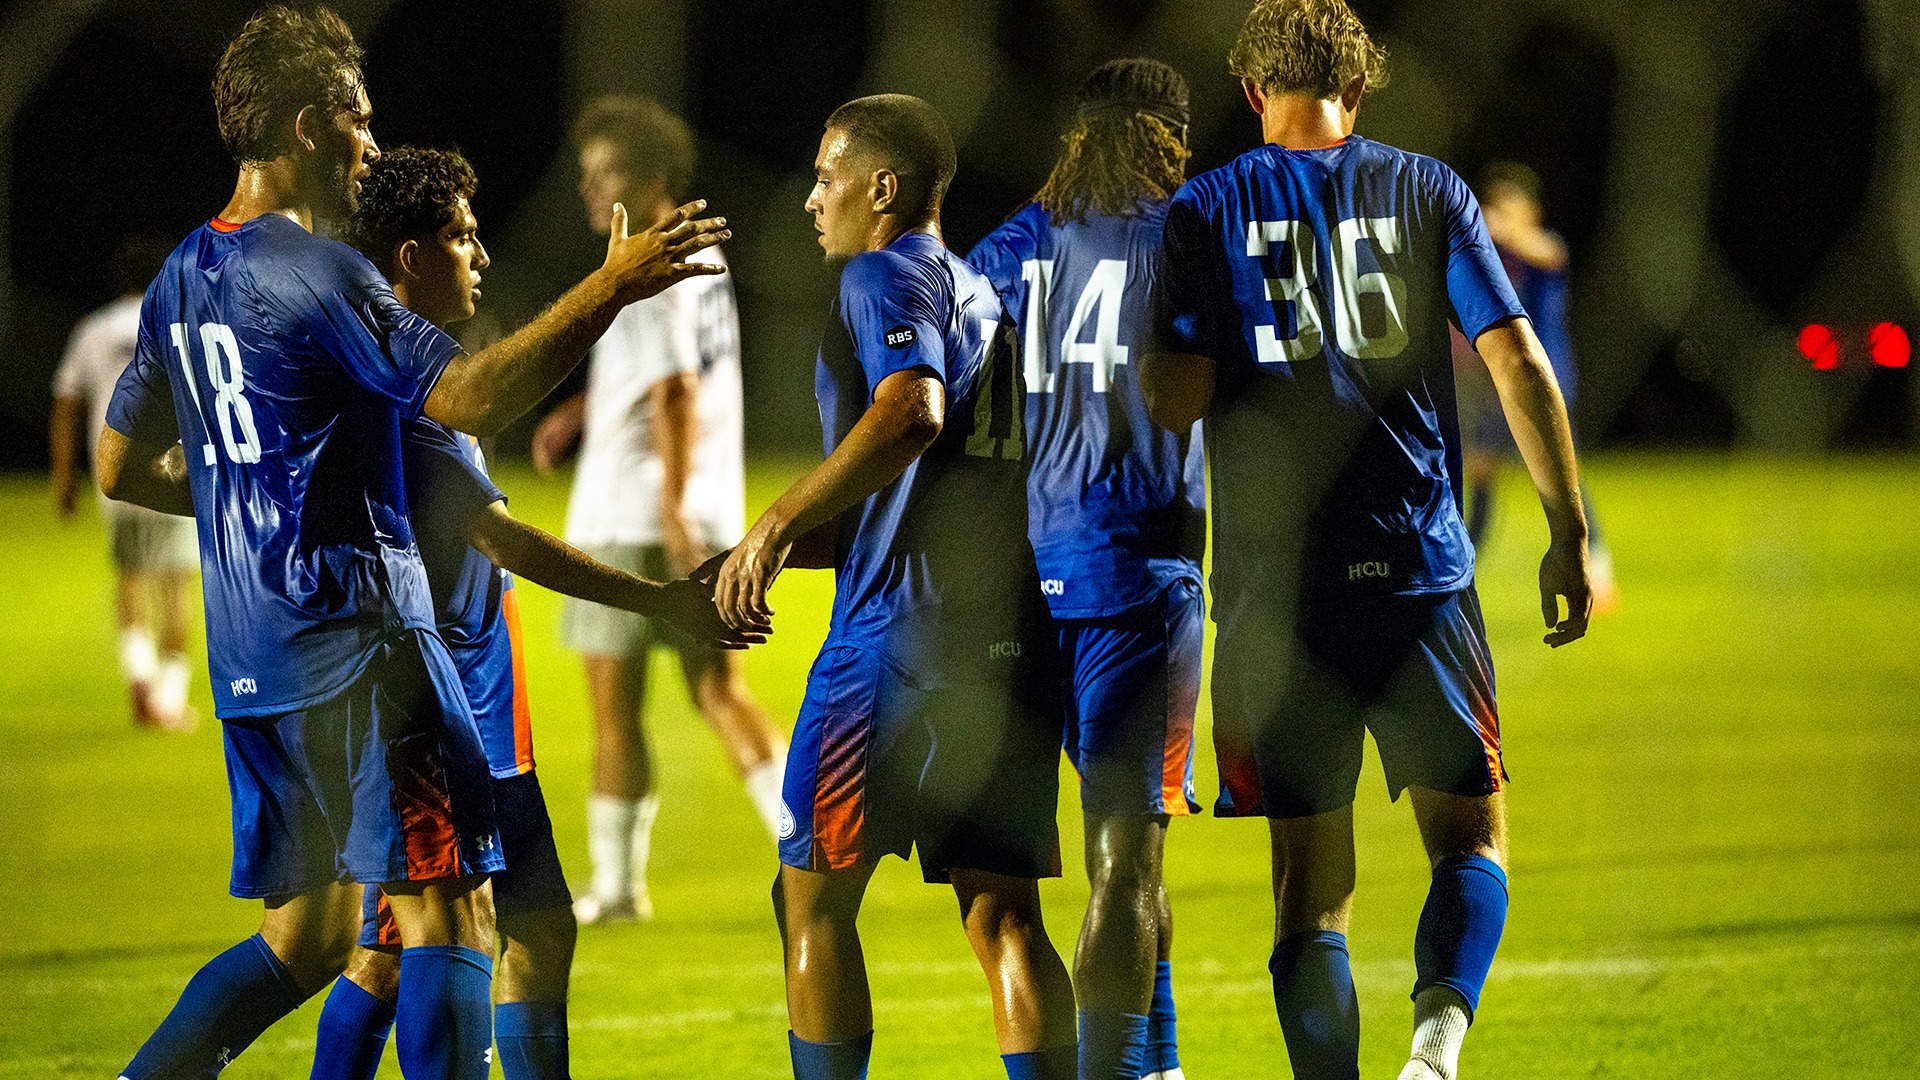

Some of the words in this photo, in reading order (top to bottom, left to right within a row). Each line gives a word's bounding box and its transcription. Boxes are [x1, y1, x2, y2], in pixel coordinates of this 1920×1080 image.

[1021, 258, 1129, 393] 14
[1246, 216, 1409, 363] 36
[887, 330, 913, 345] RBS
[169, 322, 262, 466] 18
[965, 318, 1023, 461] 11
[1347, 561, 1390, 580] HCU
[230, 677, 258, 697] HCU
[989, 641, 1021, 658] HCU
